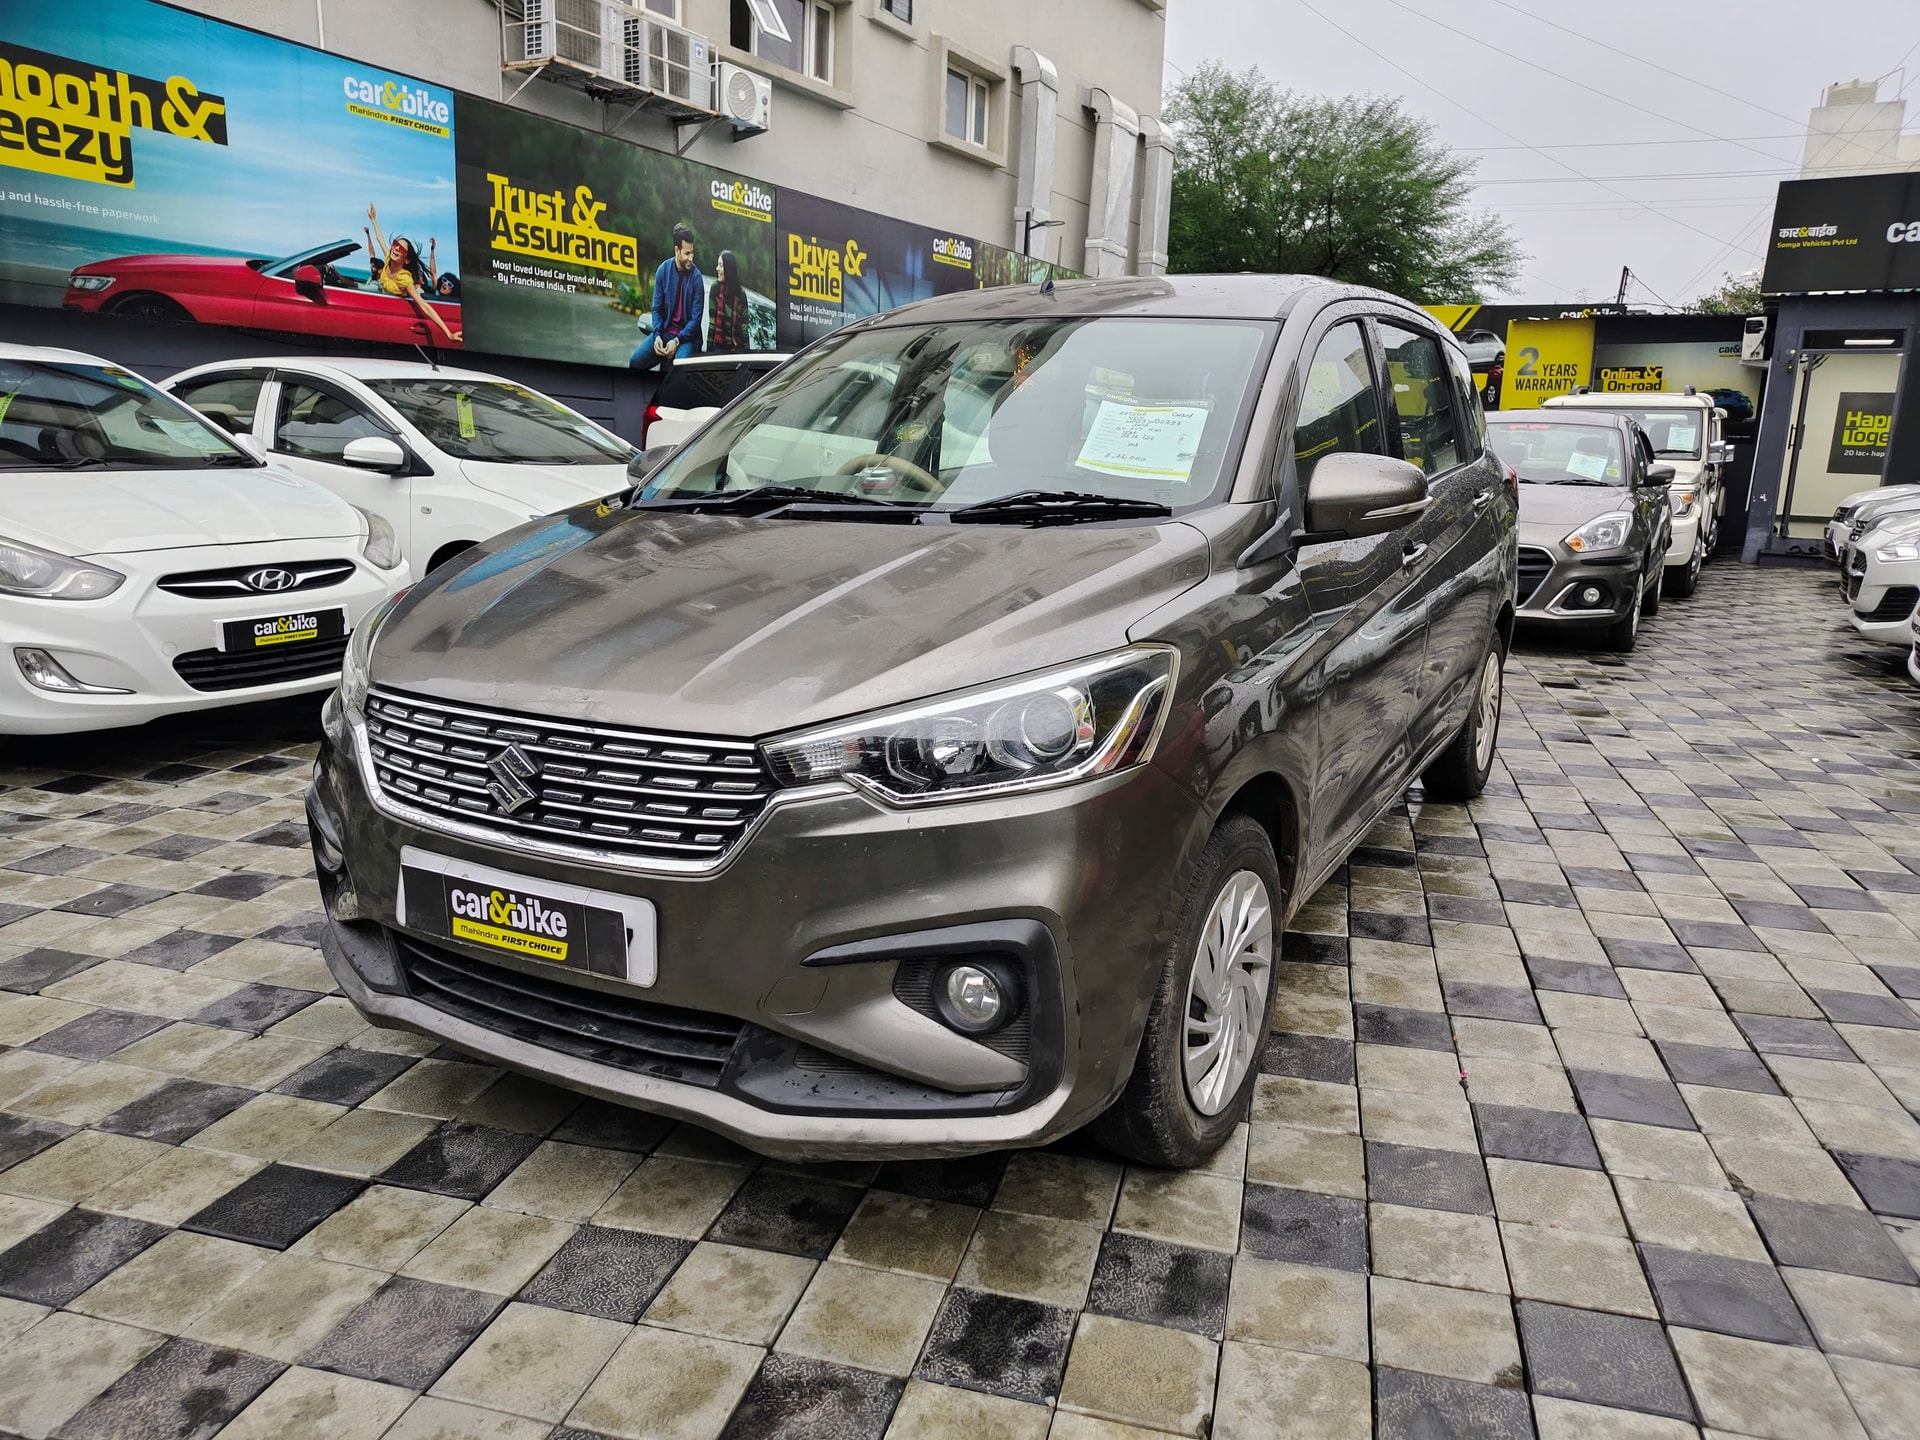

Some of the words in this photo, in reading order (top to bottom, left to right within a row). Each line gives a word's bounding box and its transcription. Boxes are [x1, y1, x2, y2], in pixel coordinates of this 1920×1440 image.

[161, 75, 225, 143] &
[343, 76, 449, 124] car&bike
[390, 115, 414, 127] FIRST
[414, 122, 442, 135] CHOICE
[8, 191, 31, 203] and
[34, 193, 99, 215] hassle-free
[102, 206, 160, 225] paperwork
[487, 172, 565, 222] Trust
[572, 185, 607, 230] &
[711, 180, 772, 211] car&bike
[491, 209, 635, 268] Assurance
[933, 237, 972, 260] car&bike
[1777, 241, 1801, 249] Somya
[788, 233, 840, 271] Drive
[843, 239, 867, 277] &
[492, 259, 512, 271] Most
[513, 262, 533, 274] loved
[534, 267, 553, 278] Used
[553, 270, 566, 280] Car
[566, 272, 587, 284] brand
[587, 276, 595, 285] of
[596, 277, 613, 289] India
[498, 272, 509, 285] By
[509, 274, 545, 289] Franchise
[546, 281, 566, 293] India,
[567, 284, 577, 294] ET
[789, 262, 840, 298] Smile
[790, 302, 800, 312] Buy
[803, 304, 812, 312] Sell
[815, 306, 837, 318] Exchange
[790, 311, 803, 321] bikes
[803, 314, 808, 322] of
[809, 316, 818, 325] any
[819, 315, 832, 325] brand
[1517, 346, 1539, 376] 2
[1542, 363, 1578, 377] YEARS
[1601, 367, 1641, 381] Online
[1644, 364, 1663, 380] &
[1515, 378, 1576, 391] WARRANTY
[1607, 379, 1662, 391] On-road
[254, 614, 318, 636] car&bike
[451, 888, 568, 938] car&bike
[501, 934, 528, 947] FIRST
[528, 941, 563, 955] CHOICE
